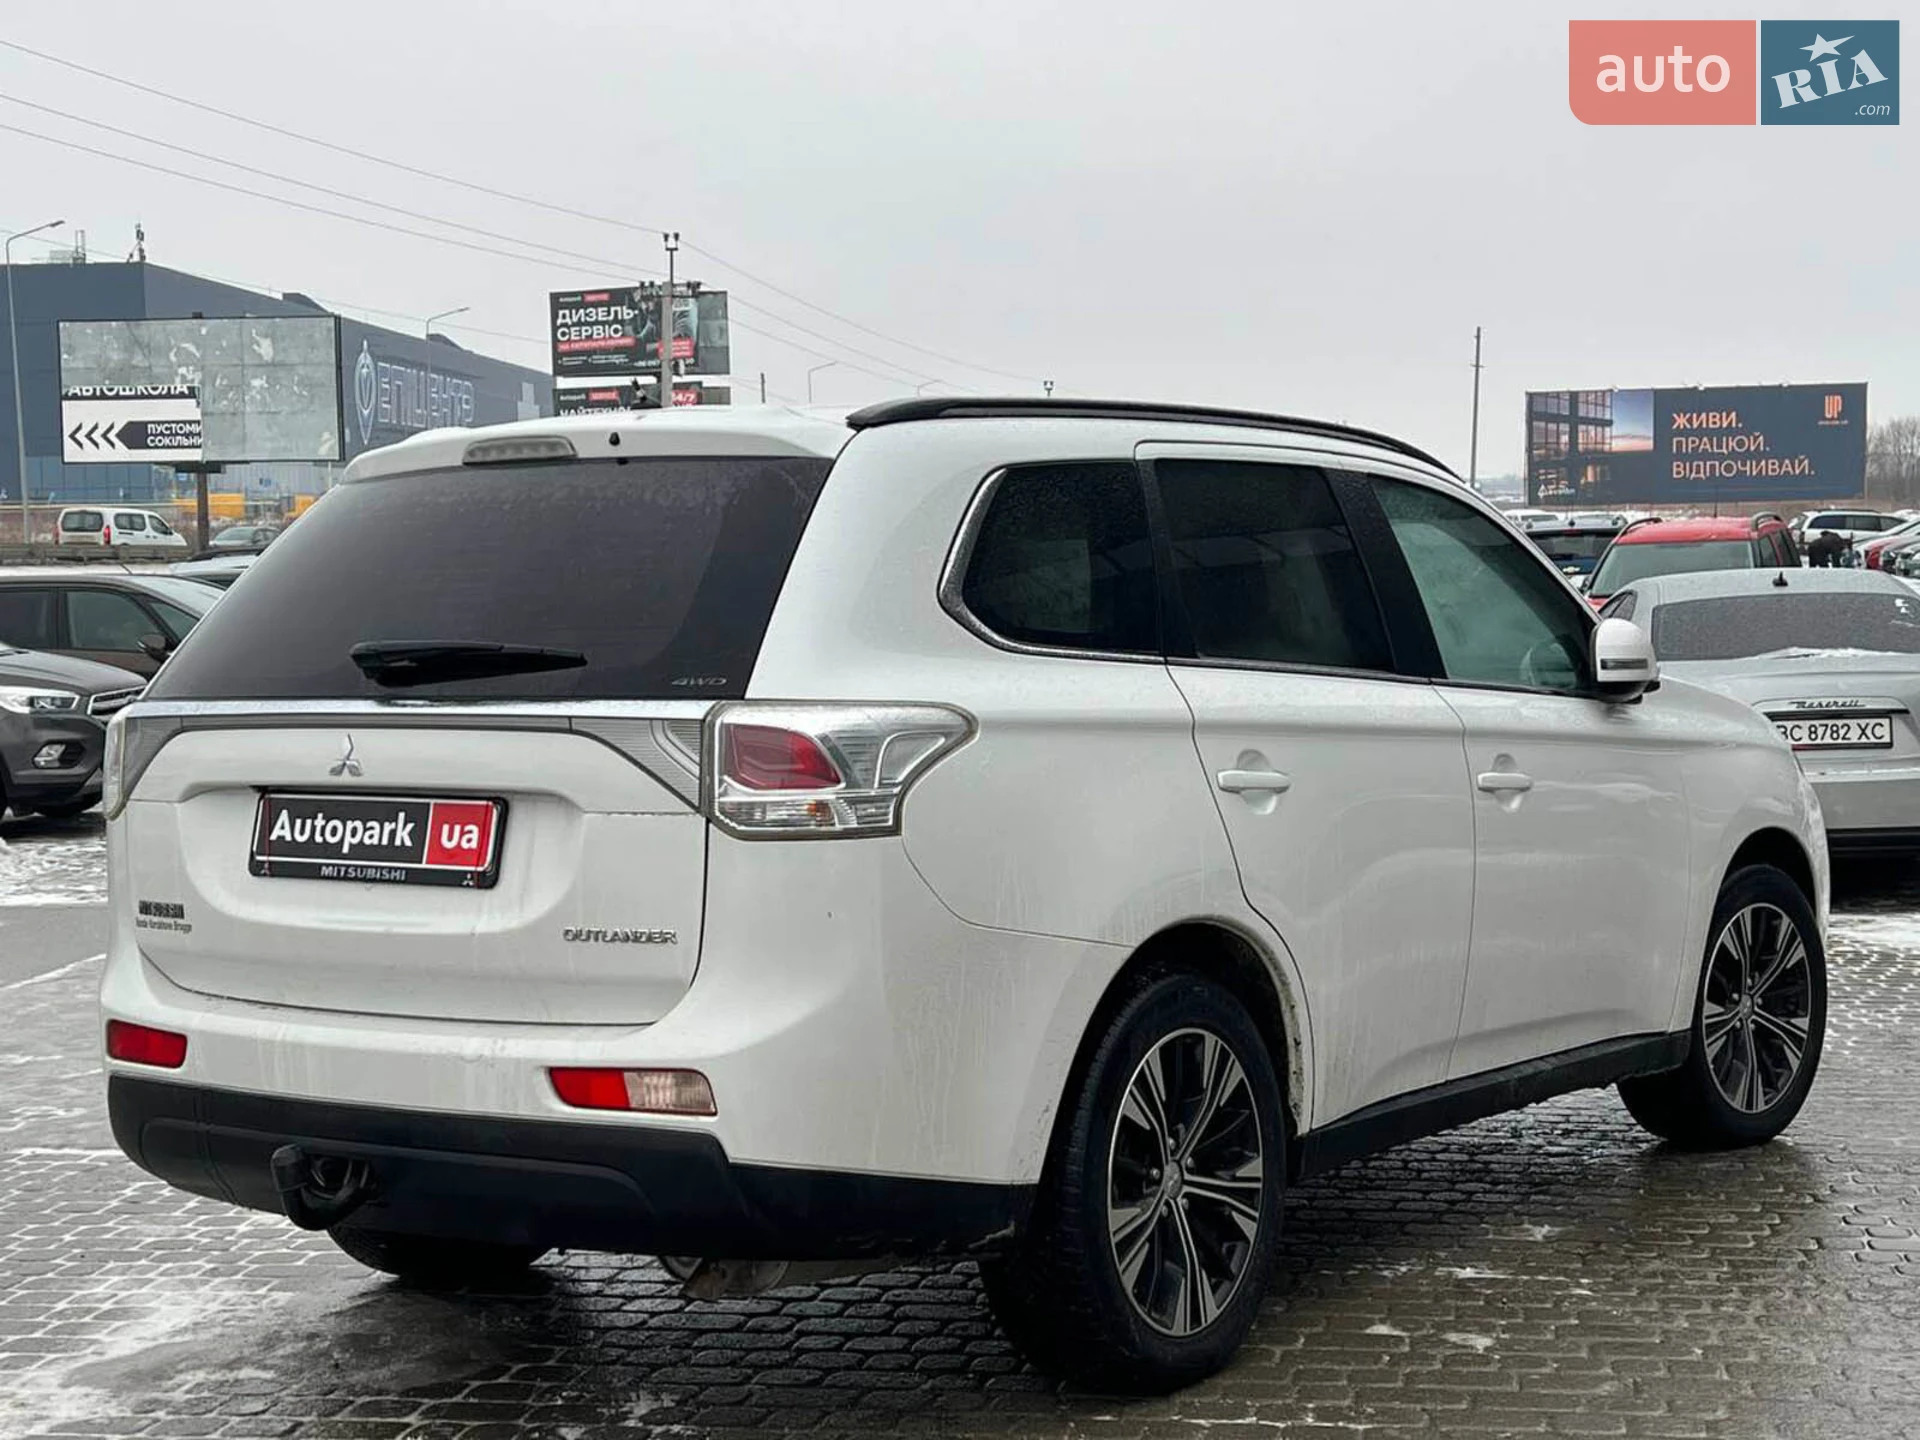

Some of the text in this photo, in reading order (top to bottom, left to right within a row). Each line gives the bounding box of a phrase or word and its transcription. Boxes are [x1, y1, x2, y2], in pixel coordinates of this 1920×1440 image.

[557, 324, 623, 341] СЕРВІС
[1672, 411, 1743, 429] ЖИВИ.
[1672, 432, 1770, 455] ПРАЦЮЙ.
[1672, 456, 1815, 480] ВІДПОЧИВАЙ.
[671, 676, 728, 686] 4WD
[1808, 723, 1852, 741] 8782
[1857, 722, 1885, 740] XC
[269, 809, 479, 853] Autopark ua
[320, 865, 406, 881] MITSUBISHI
[563, 928, 678, 945] OUTLANDER
